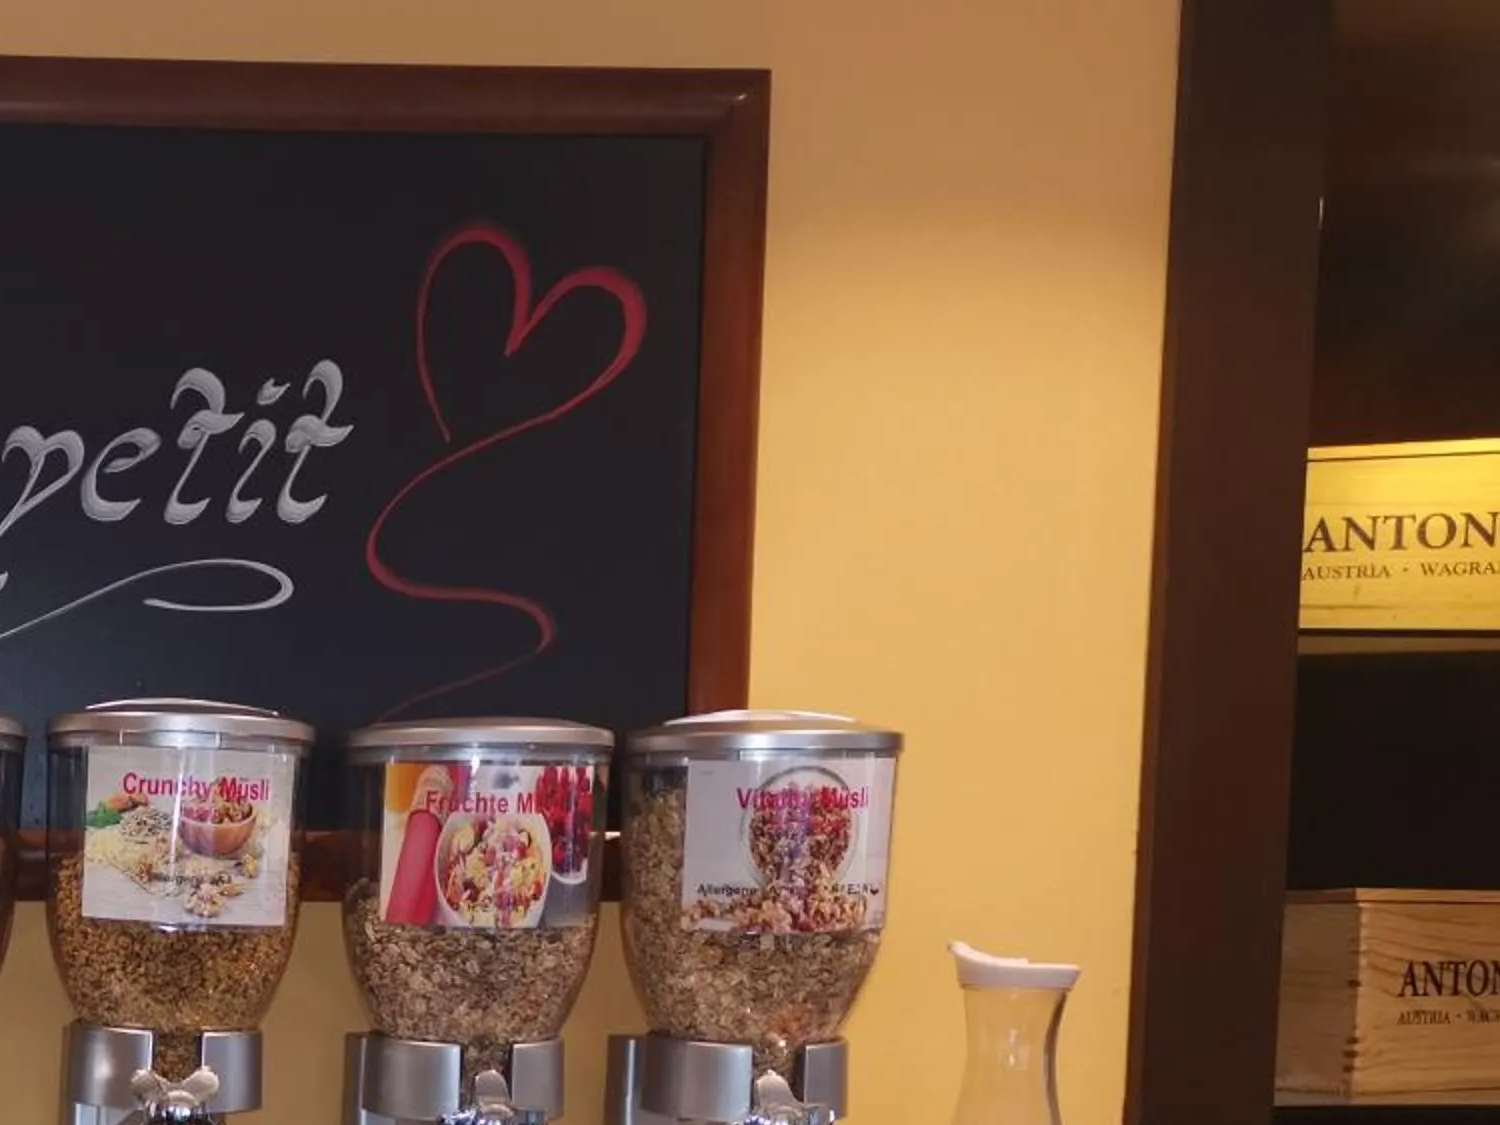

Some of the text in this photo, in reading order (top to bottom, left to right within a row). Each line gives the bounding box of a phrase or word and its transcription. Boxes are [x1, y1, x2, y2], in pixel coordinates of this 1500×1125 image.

[1302, 511, 1500, 553] ANTON
[1302, 559, 1500, 581] AUSTRIA WAGRA
[122, 771, 212, 801] Crunchy
